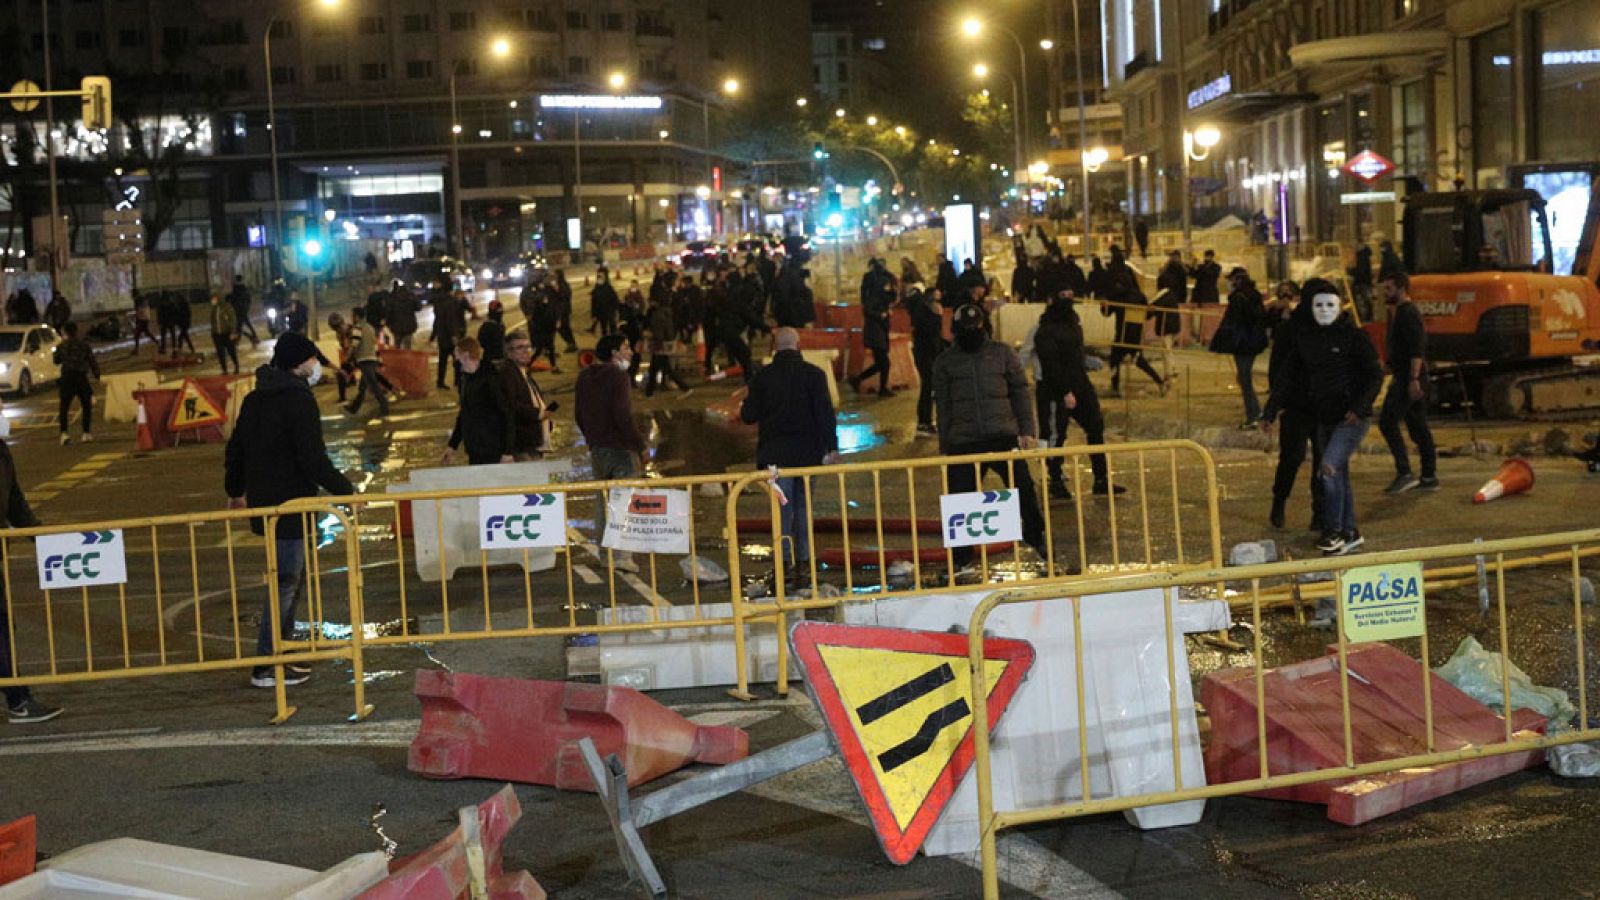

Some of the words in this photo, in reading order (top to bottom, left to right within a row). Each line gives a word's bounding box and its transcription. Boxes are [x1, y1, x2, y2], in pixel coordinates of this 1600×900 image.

[486, 513, 541, 542] FCC
[633, 526, 654, 535] PLAZA
[949, 510, 1000, 540] FCC
[45, 552, 101, 582] FCC
[1348, 577, 1418, 603] PACSA
